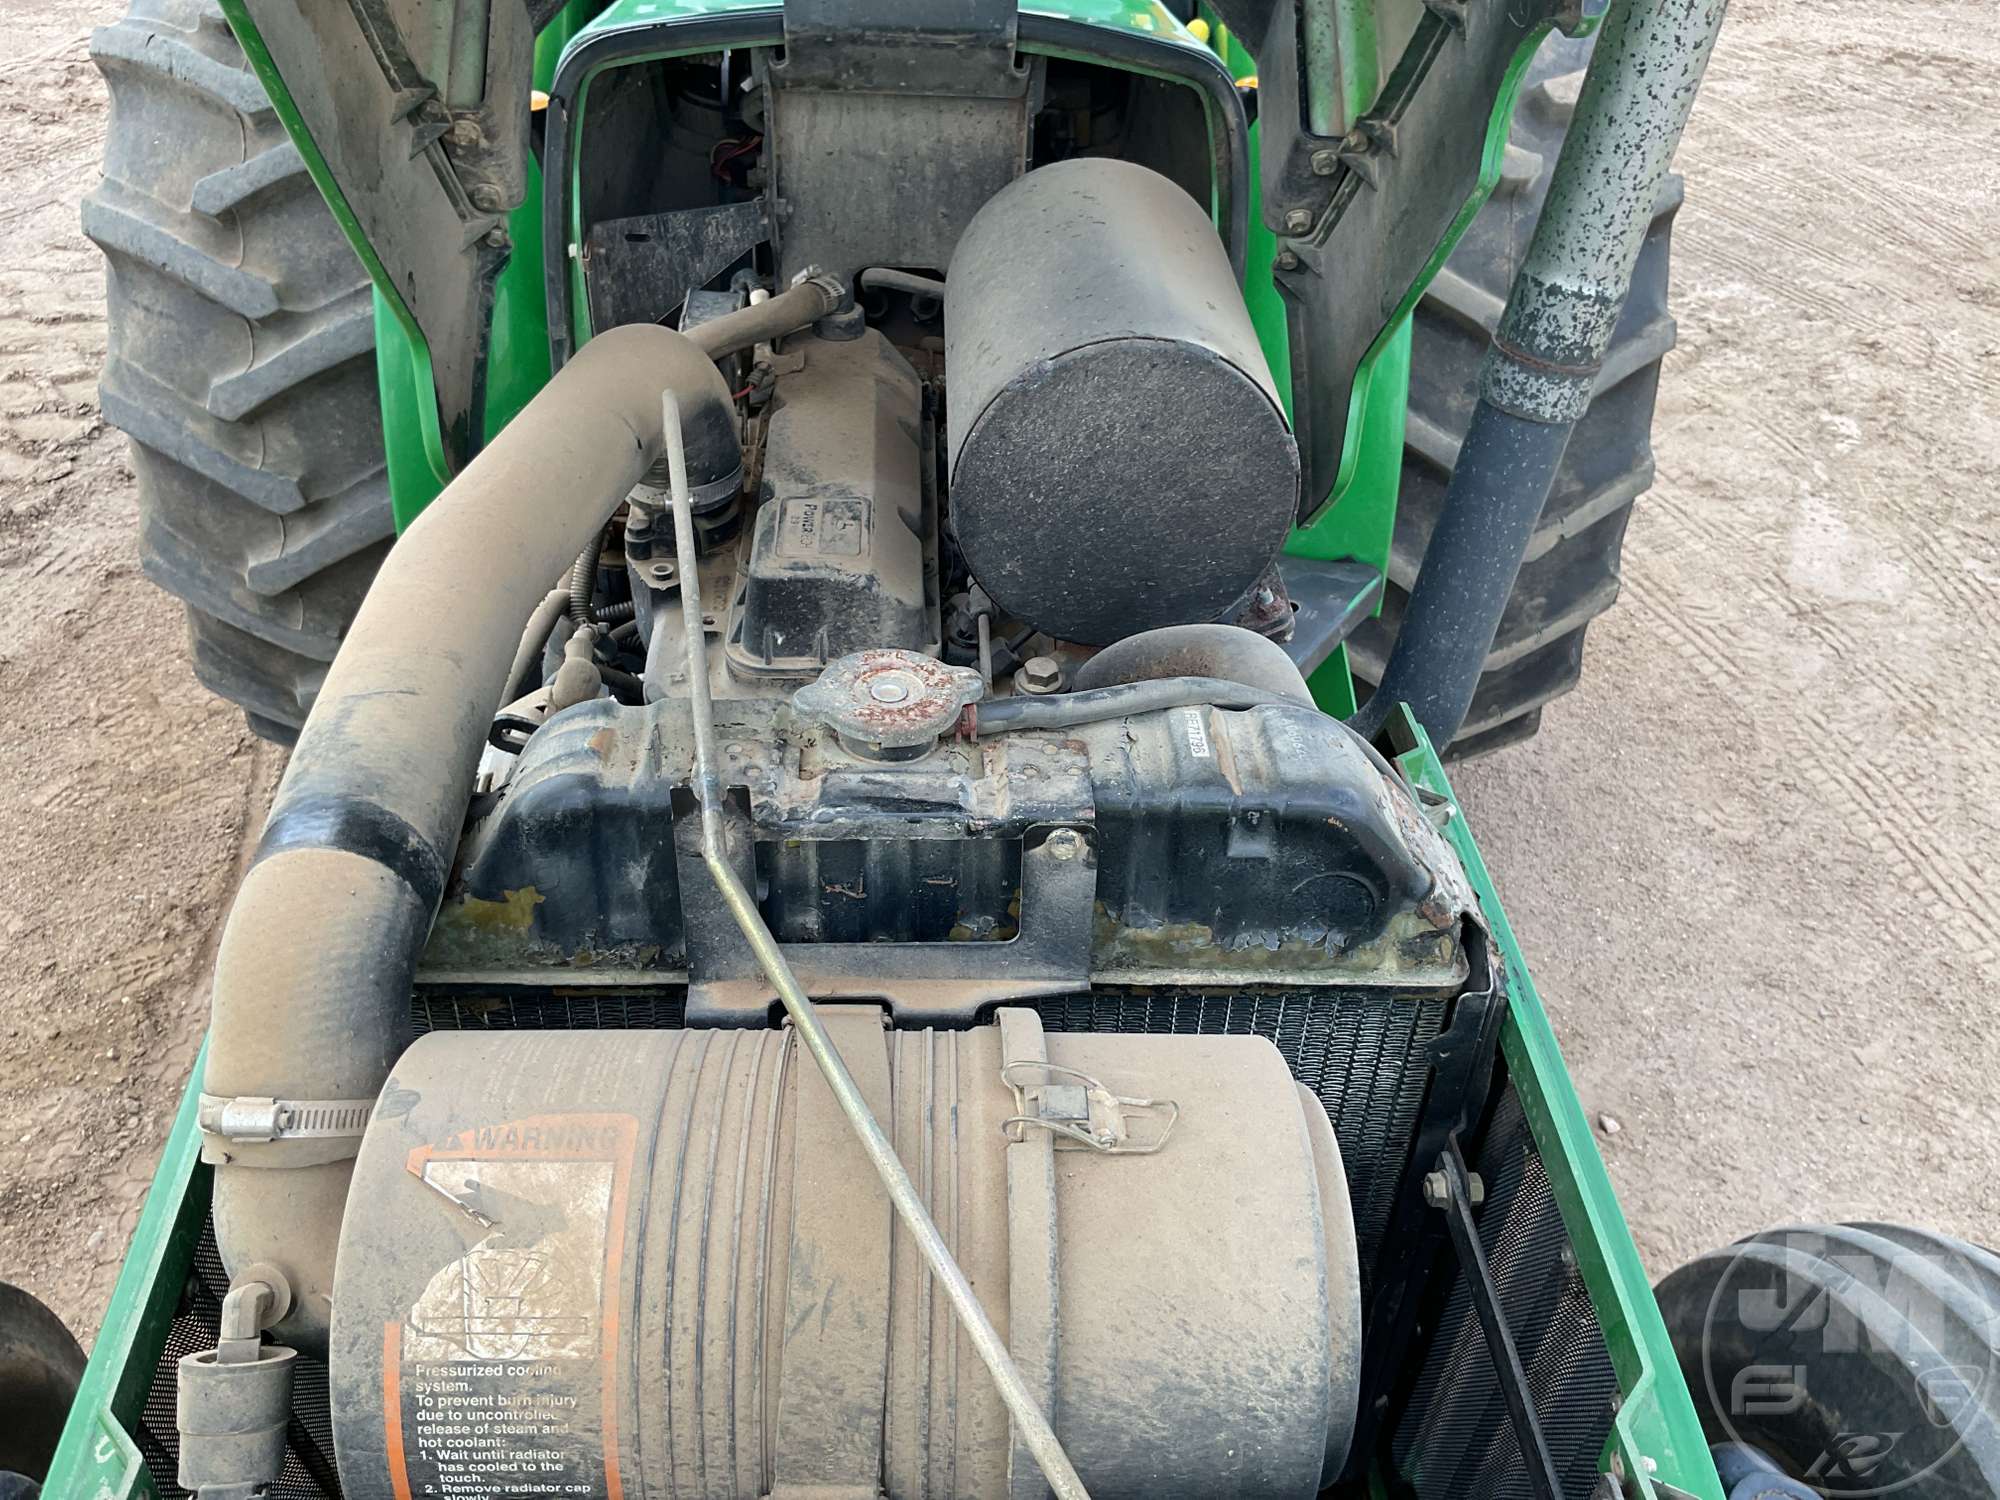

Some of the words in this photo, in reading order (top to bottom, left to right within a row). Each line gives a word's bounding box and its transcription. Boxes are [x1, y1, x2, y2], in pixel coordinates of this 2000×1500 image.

[473, 1125, 619, 1151] WARNING
[416, 1364, 502, 1376] Pressurized
[415, 1380, 472, 1394] system.
[416, 1395, 433, 1406] To
[438, 1395, 493, 1408] prevent
[498, 1395, 532, 1406] burn
[536, 1394, 577, 1408] injury
[416, 1410, 443, 1420] due
[448, 1410, 462, 1420] to
[417, 1424, 470, 1434] release
[474, 1424, 489, 1434] of
[493, 1424, 537, 1434] steam
[542, 1424, 569, 1433] and
[418, 1437, 442, 1448] hot
[446, 1437, 506, 1448] coolant:
[419, 1451, 432, 1460] 1.
[437, 1450, 468, 1460] Wait
[472, 1450, 505, 1459] until
[509, 1449, 564, 1459] radiator
[438, 1462, 464, 1471] has
[468, 1462, 518, 1471] cooled
[522, 1462, 536, 1471] to
[541, 1462, 563, 1471] the
[440, 1474, 485, 1482] touch.
[425, 1485, 438, 1493] 2.
[442, 1484, 500, 1493] Remove
[505, 1483, 560, 1492] radiator
[565, 1484, 591, 1493] cap
